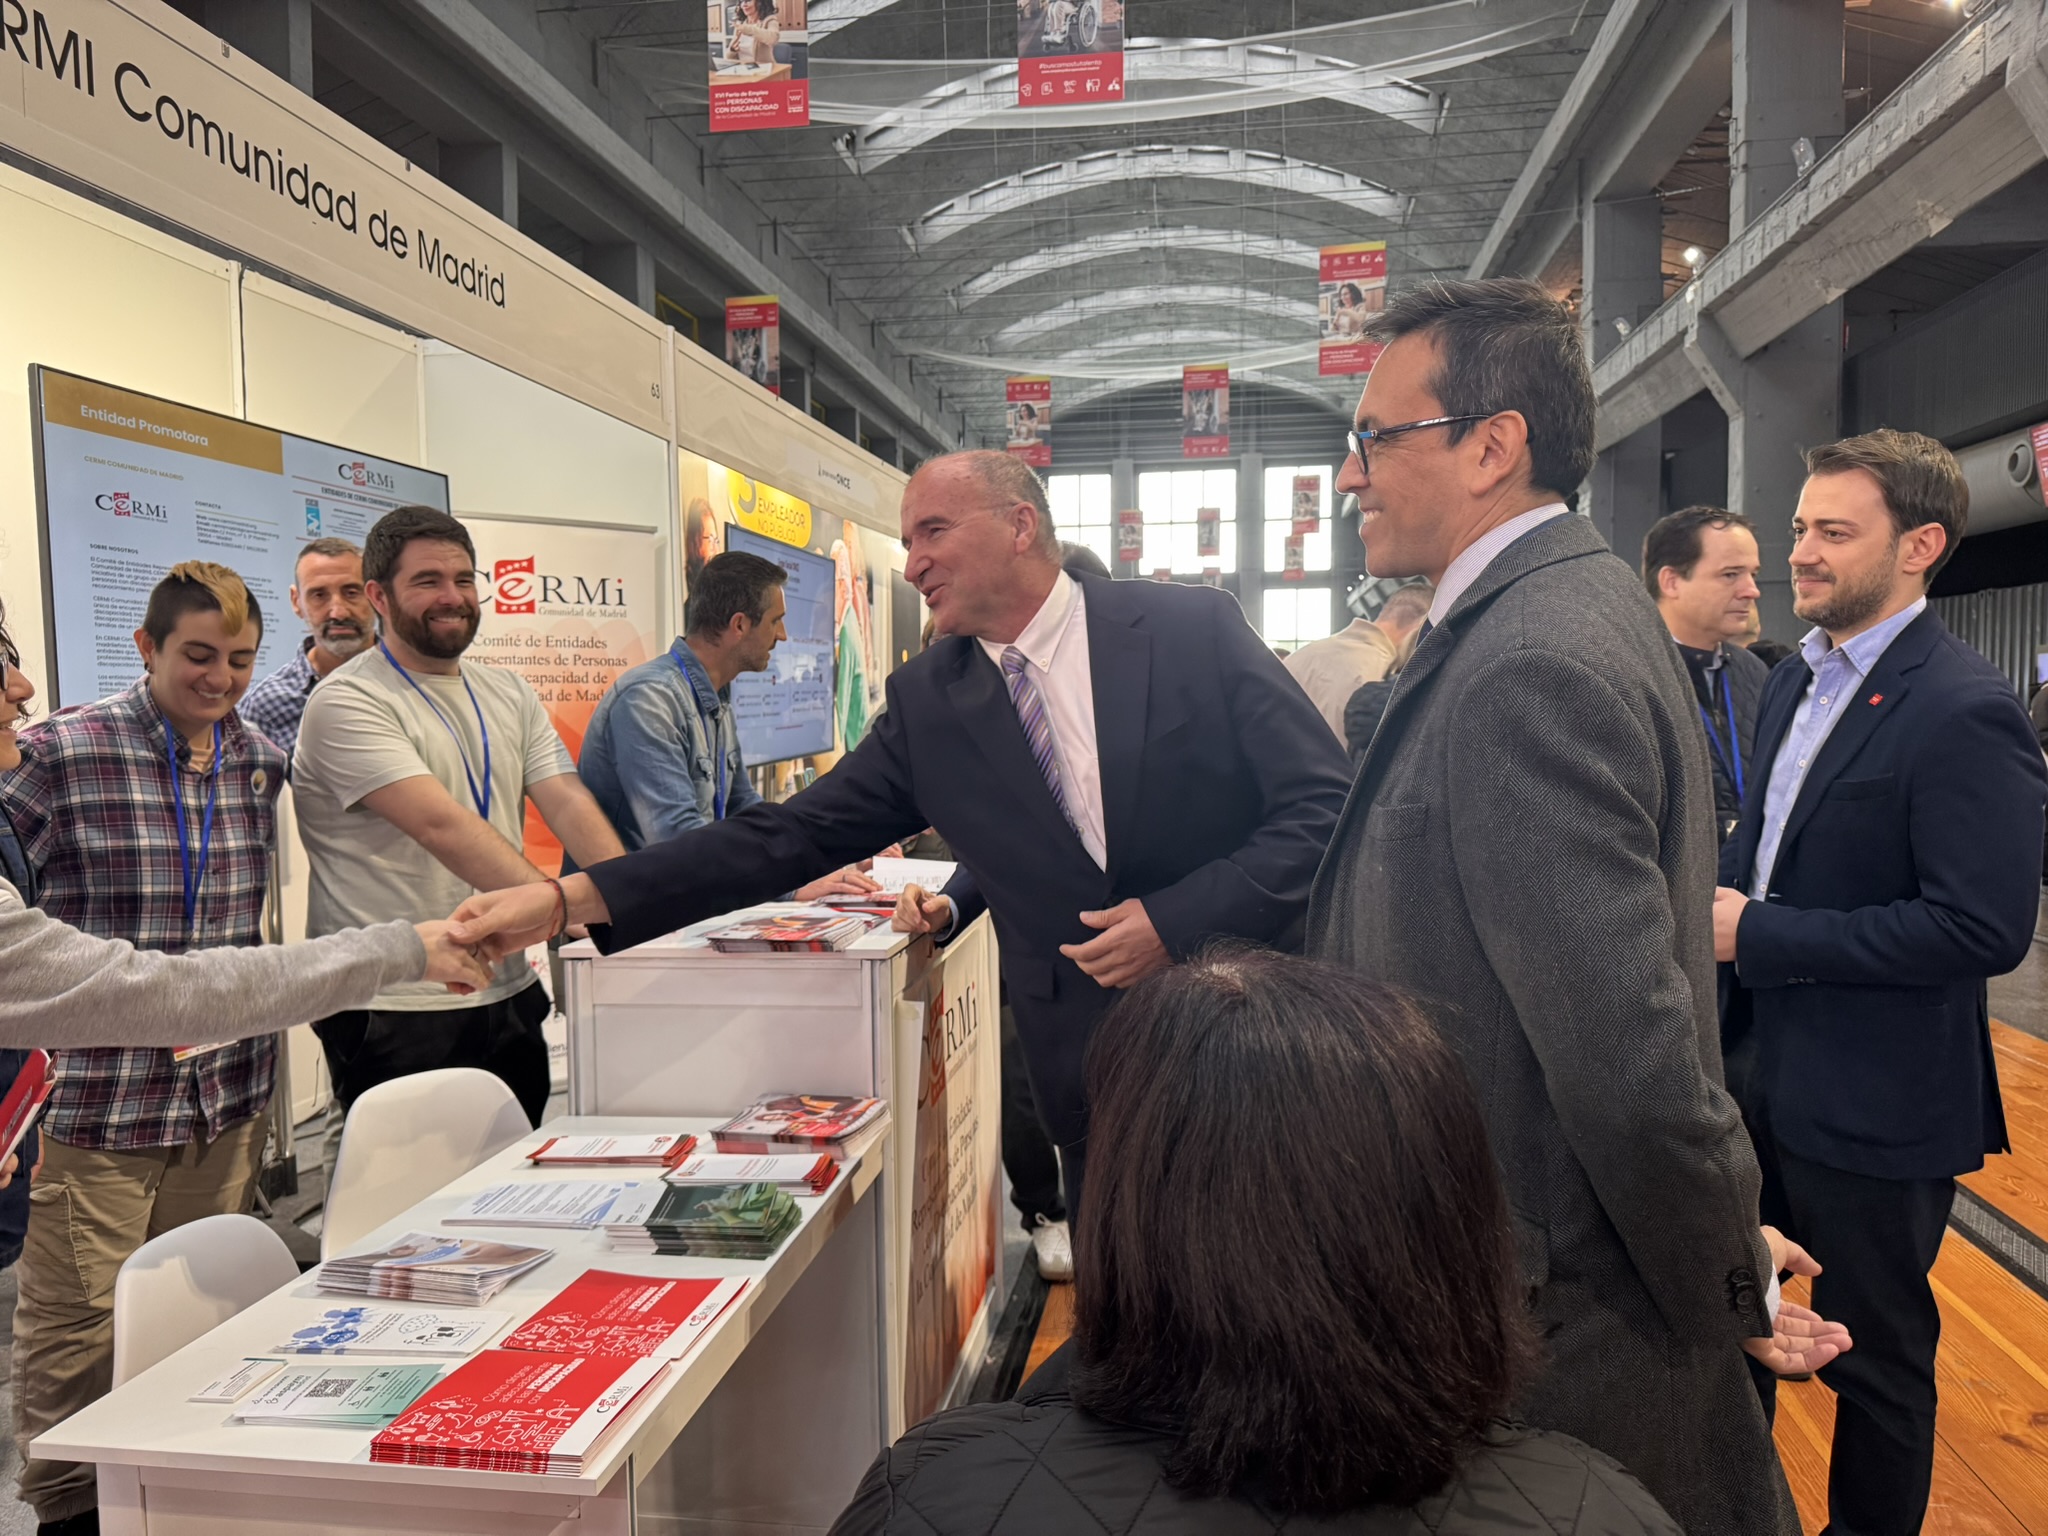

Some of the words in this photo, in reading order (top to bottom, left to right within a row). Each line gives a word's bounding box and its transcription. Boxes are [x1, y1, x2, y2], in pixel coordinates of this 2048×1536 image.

[726, 97, 762, 105] PERSONAS
[730, 103, 779, 113] DISCAPACIDAD
[0, 0, 95, 97] RMI
[114, 62, 357, 234] Comunidad
[368, 209, 408, 259] de
[417, 229, 505, 309] Madrid
[650, 382, 661, 399] 63
[80, 404, 136, 430] Entidad
[139, 420, 209, 447] Promotora
[84, 455, 106, 465] CERMI
[107, 459, 149, 474] COMUNIDAD
[159, 470, 184, 481] MADRID
[758, 497, 806, 529] EMPLEADOR
[758, 518, 768, 533] NO
[769, 522, 796, 543] PÚBLICO
[538, 607, 584, 617] Comunidad
[586, 609, 596, 618] de
[599, 610, 627, 618] Madrid
[472, 634, 521, 647] Comité
[525, 635, 542, 648] de
[546, 636, 607, 649] Entidades
[462, 655, 551, 665] presentantes
[554, 654, 570, 666] de
[573, 654, 628, 667] Personas
[524, 672, 589, 687] capacidad
[592, 672, 608, 684] de
[556, 689, 572, 702] de
[576, 689, 604, 702] Mad
[526, 1363, 564, 1390] PERSONAS
[482, 1384, 510, 1402] Cómo
